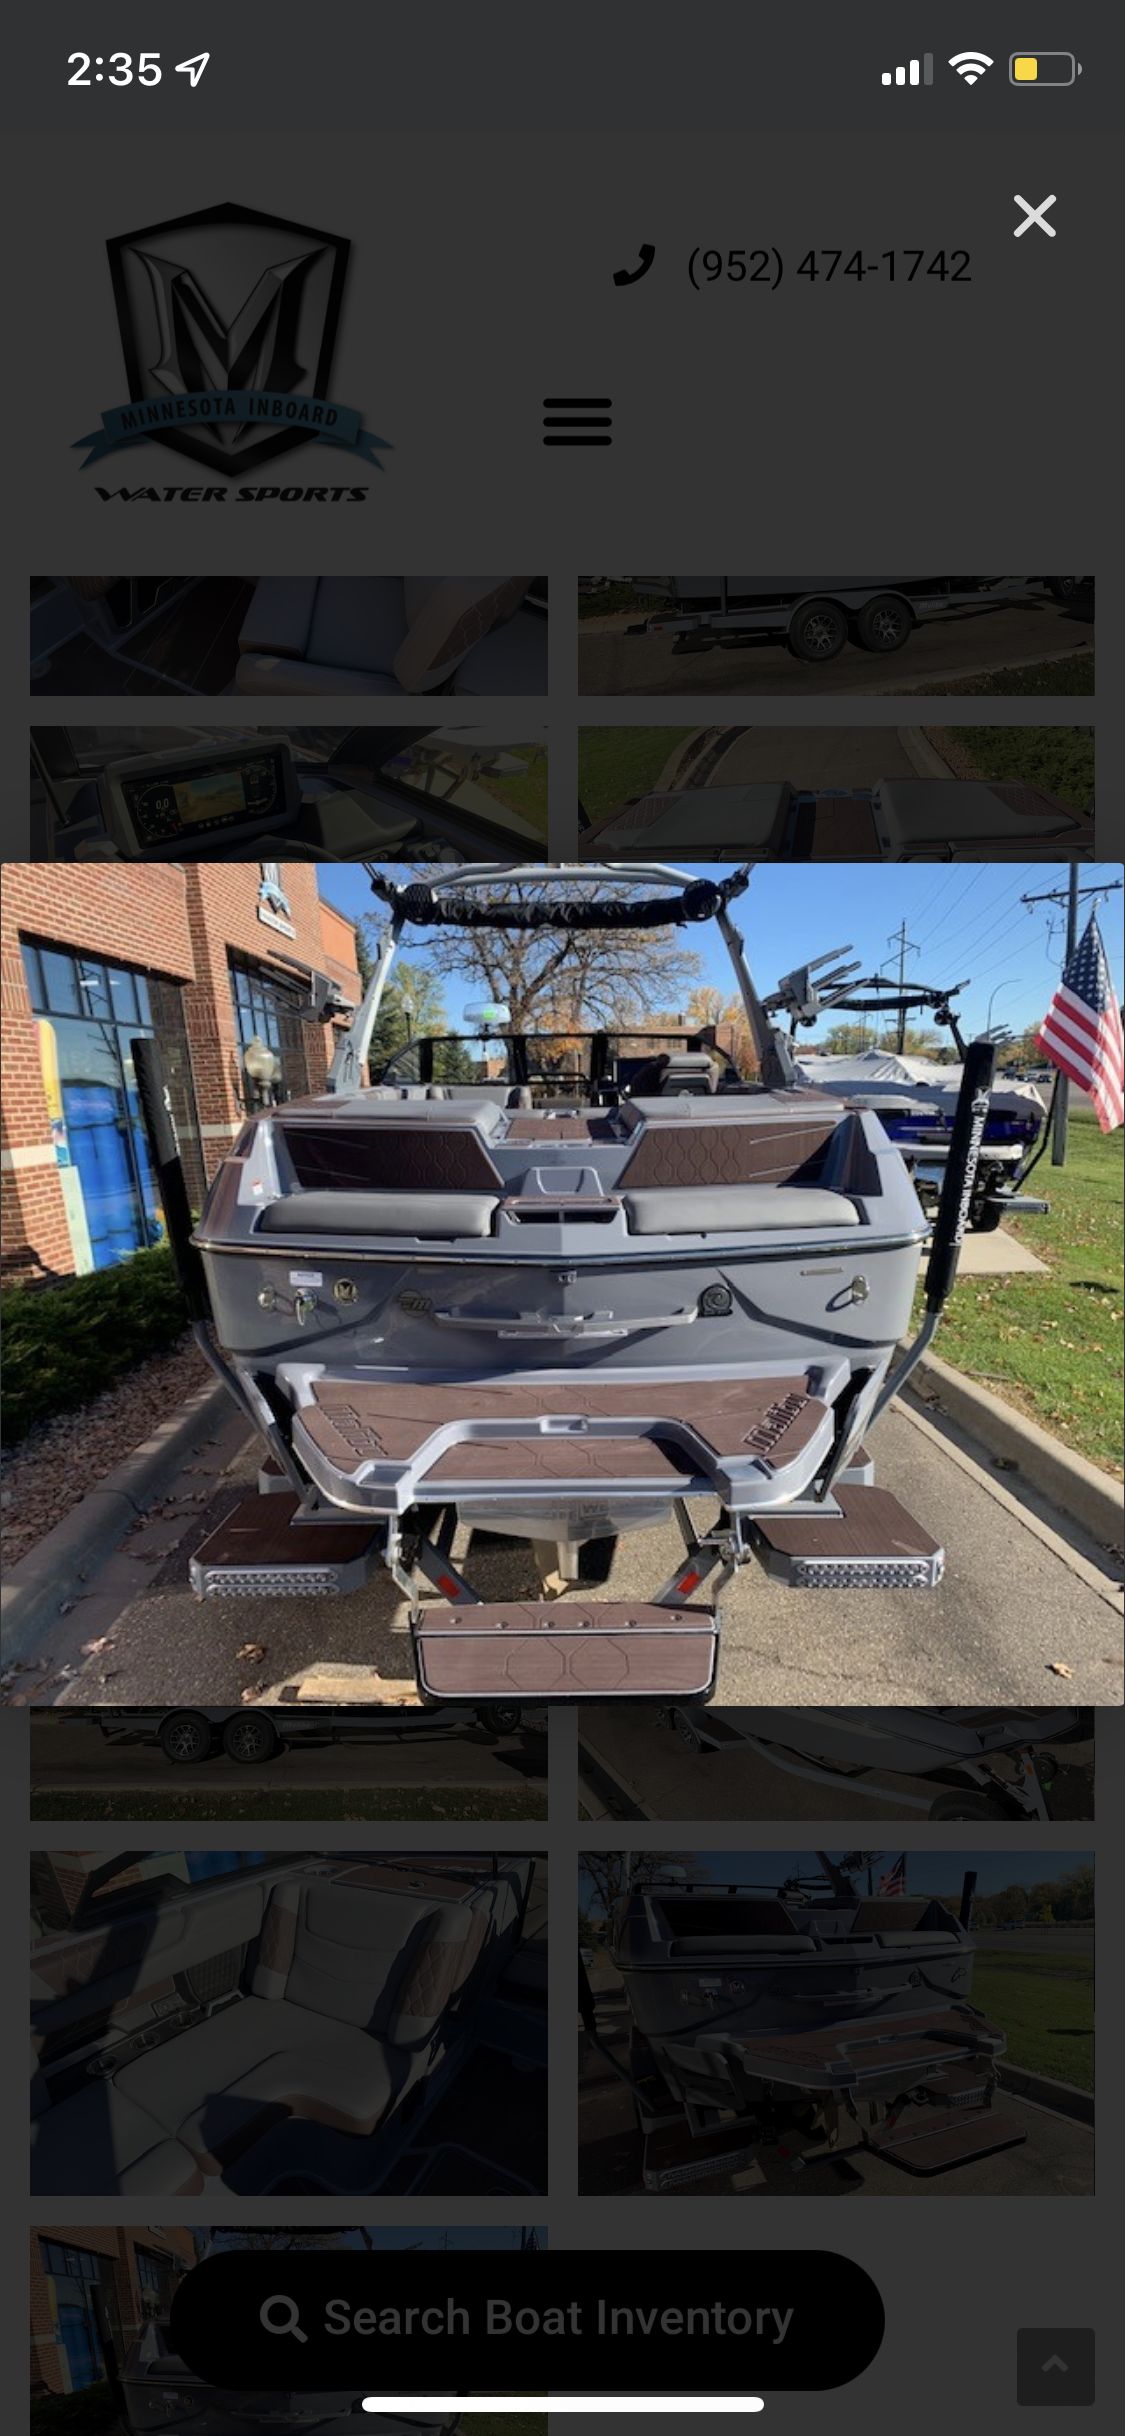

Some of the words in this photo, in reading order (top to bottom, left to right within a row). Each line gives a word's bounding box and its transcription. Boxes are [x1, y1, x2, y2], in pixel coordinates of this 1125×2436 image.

[67, 52, 163, 87] 2:35
[688, 246, 784, 291] (952)
[796, 249, 972, 282] 474-1742
[120, 397, 236, 430] MINNESOTA
[249, 397, 339, 427] INBOARD
[94, 486, 228, 503] WATER
[235, 486, 370, 503] SPORTS
[324, 2297, 470, 2336] Search
[487, 2299, 582, 2336] Boat
[598, 2299, 794, 2345] Inventory
